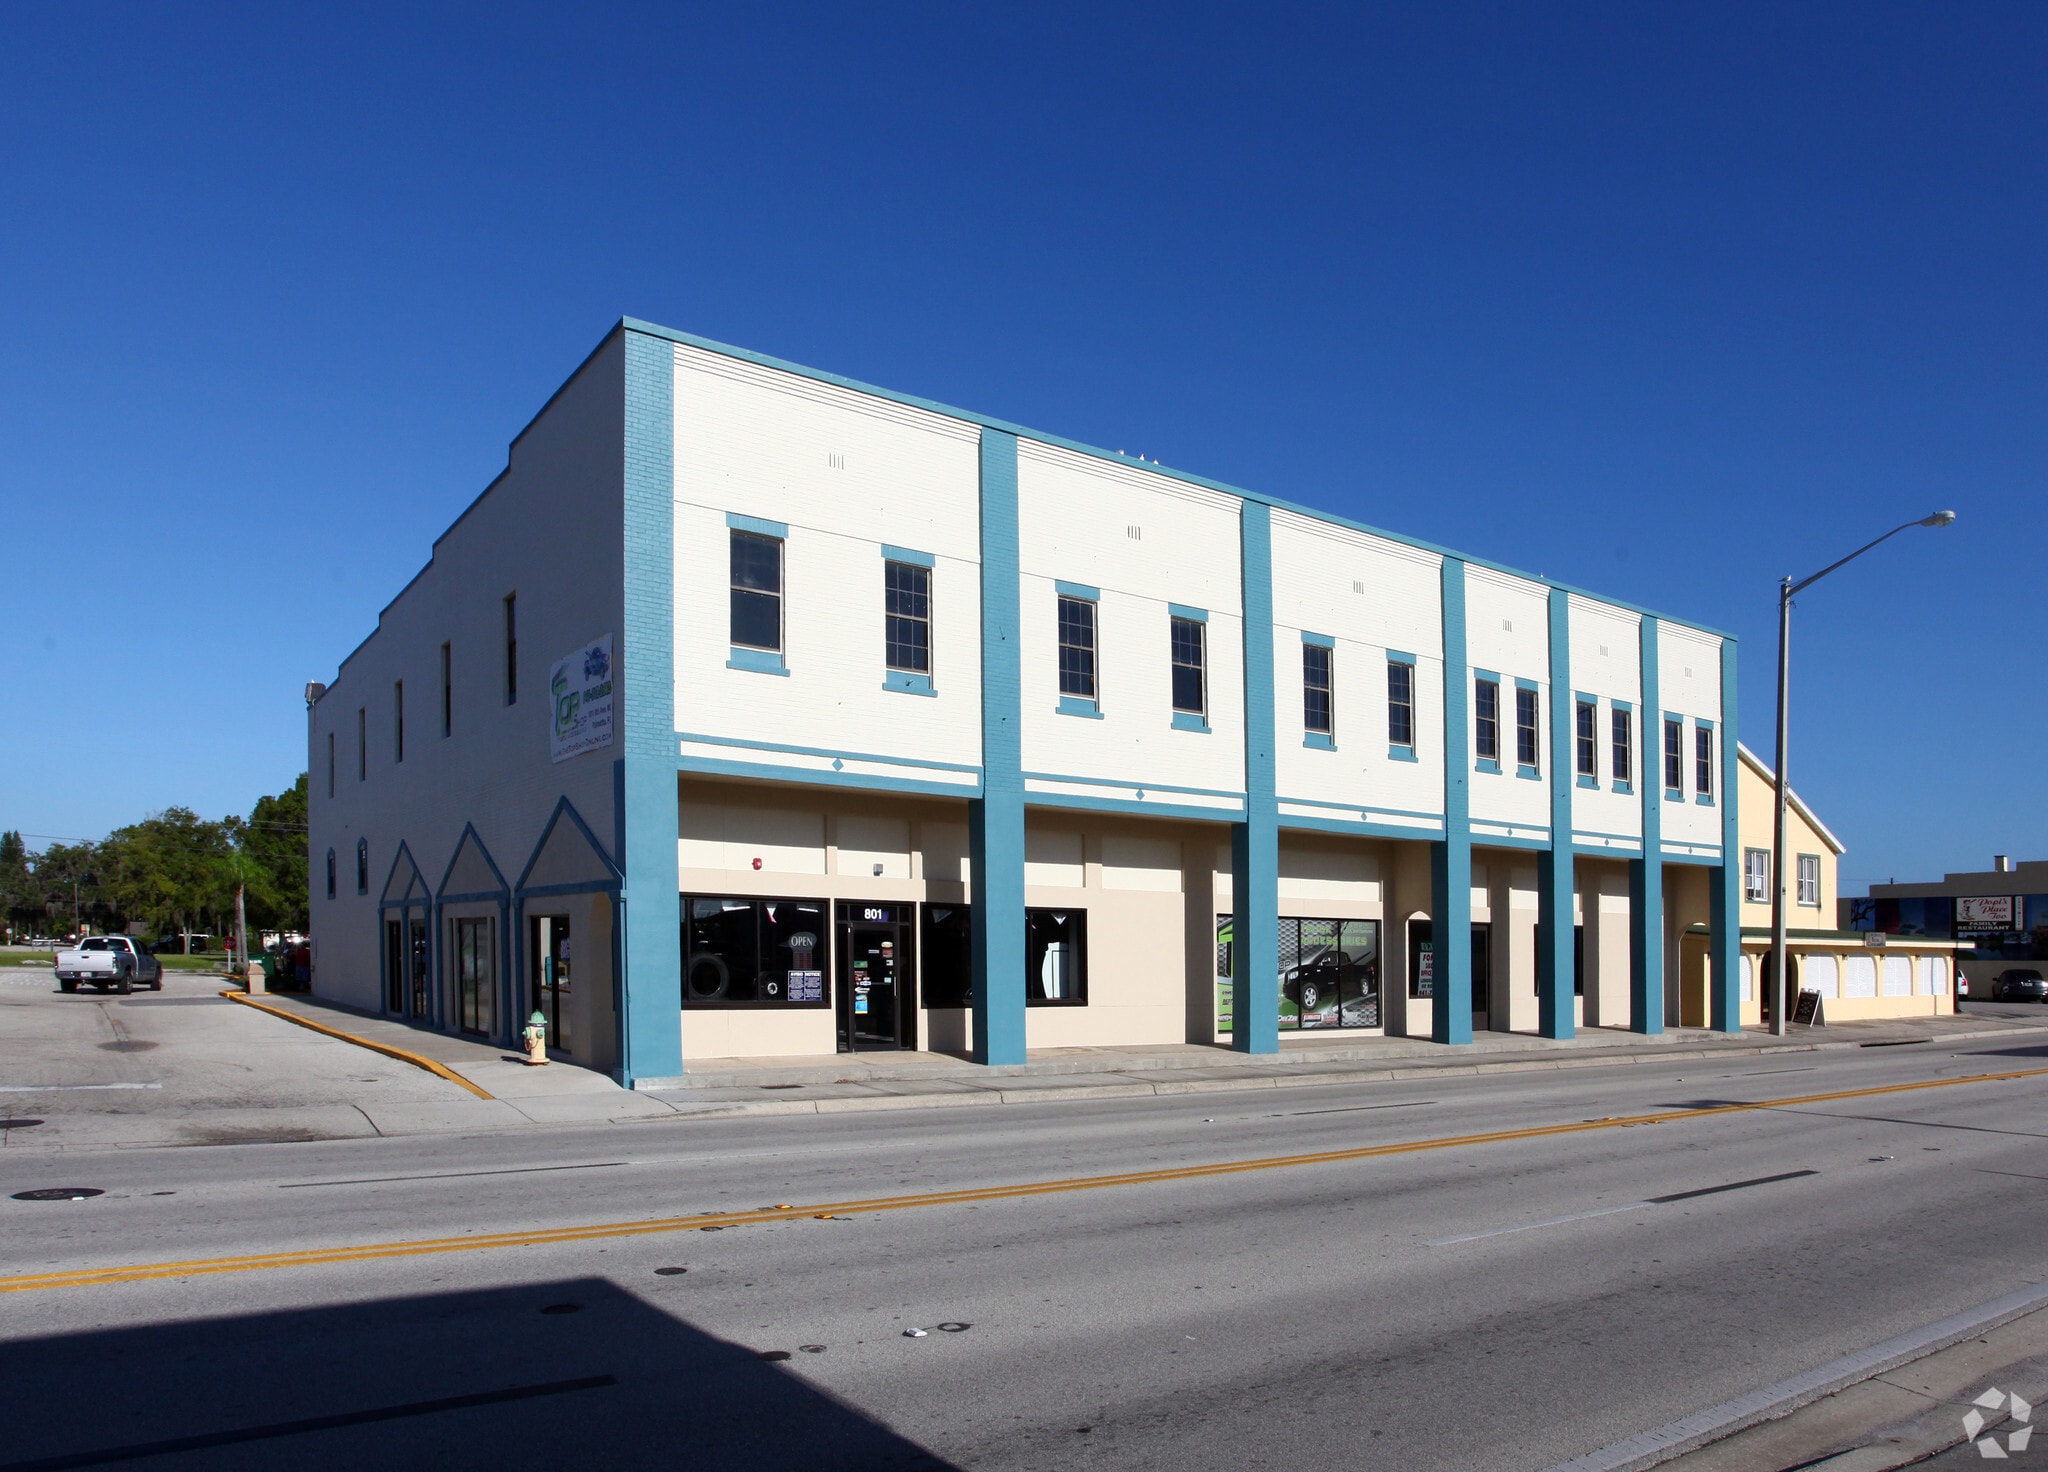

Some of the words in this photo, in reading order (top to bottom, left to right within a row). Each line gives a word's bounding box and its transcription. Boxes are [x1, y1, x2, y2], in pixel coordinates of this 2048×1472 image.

[864, 908, 882, 920] 801
[1981, 906, 2008, 914] Place
[1988, 912, 2007, 920] Too
[791, 936, 813, 946] OPEN
